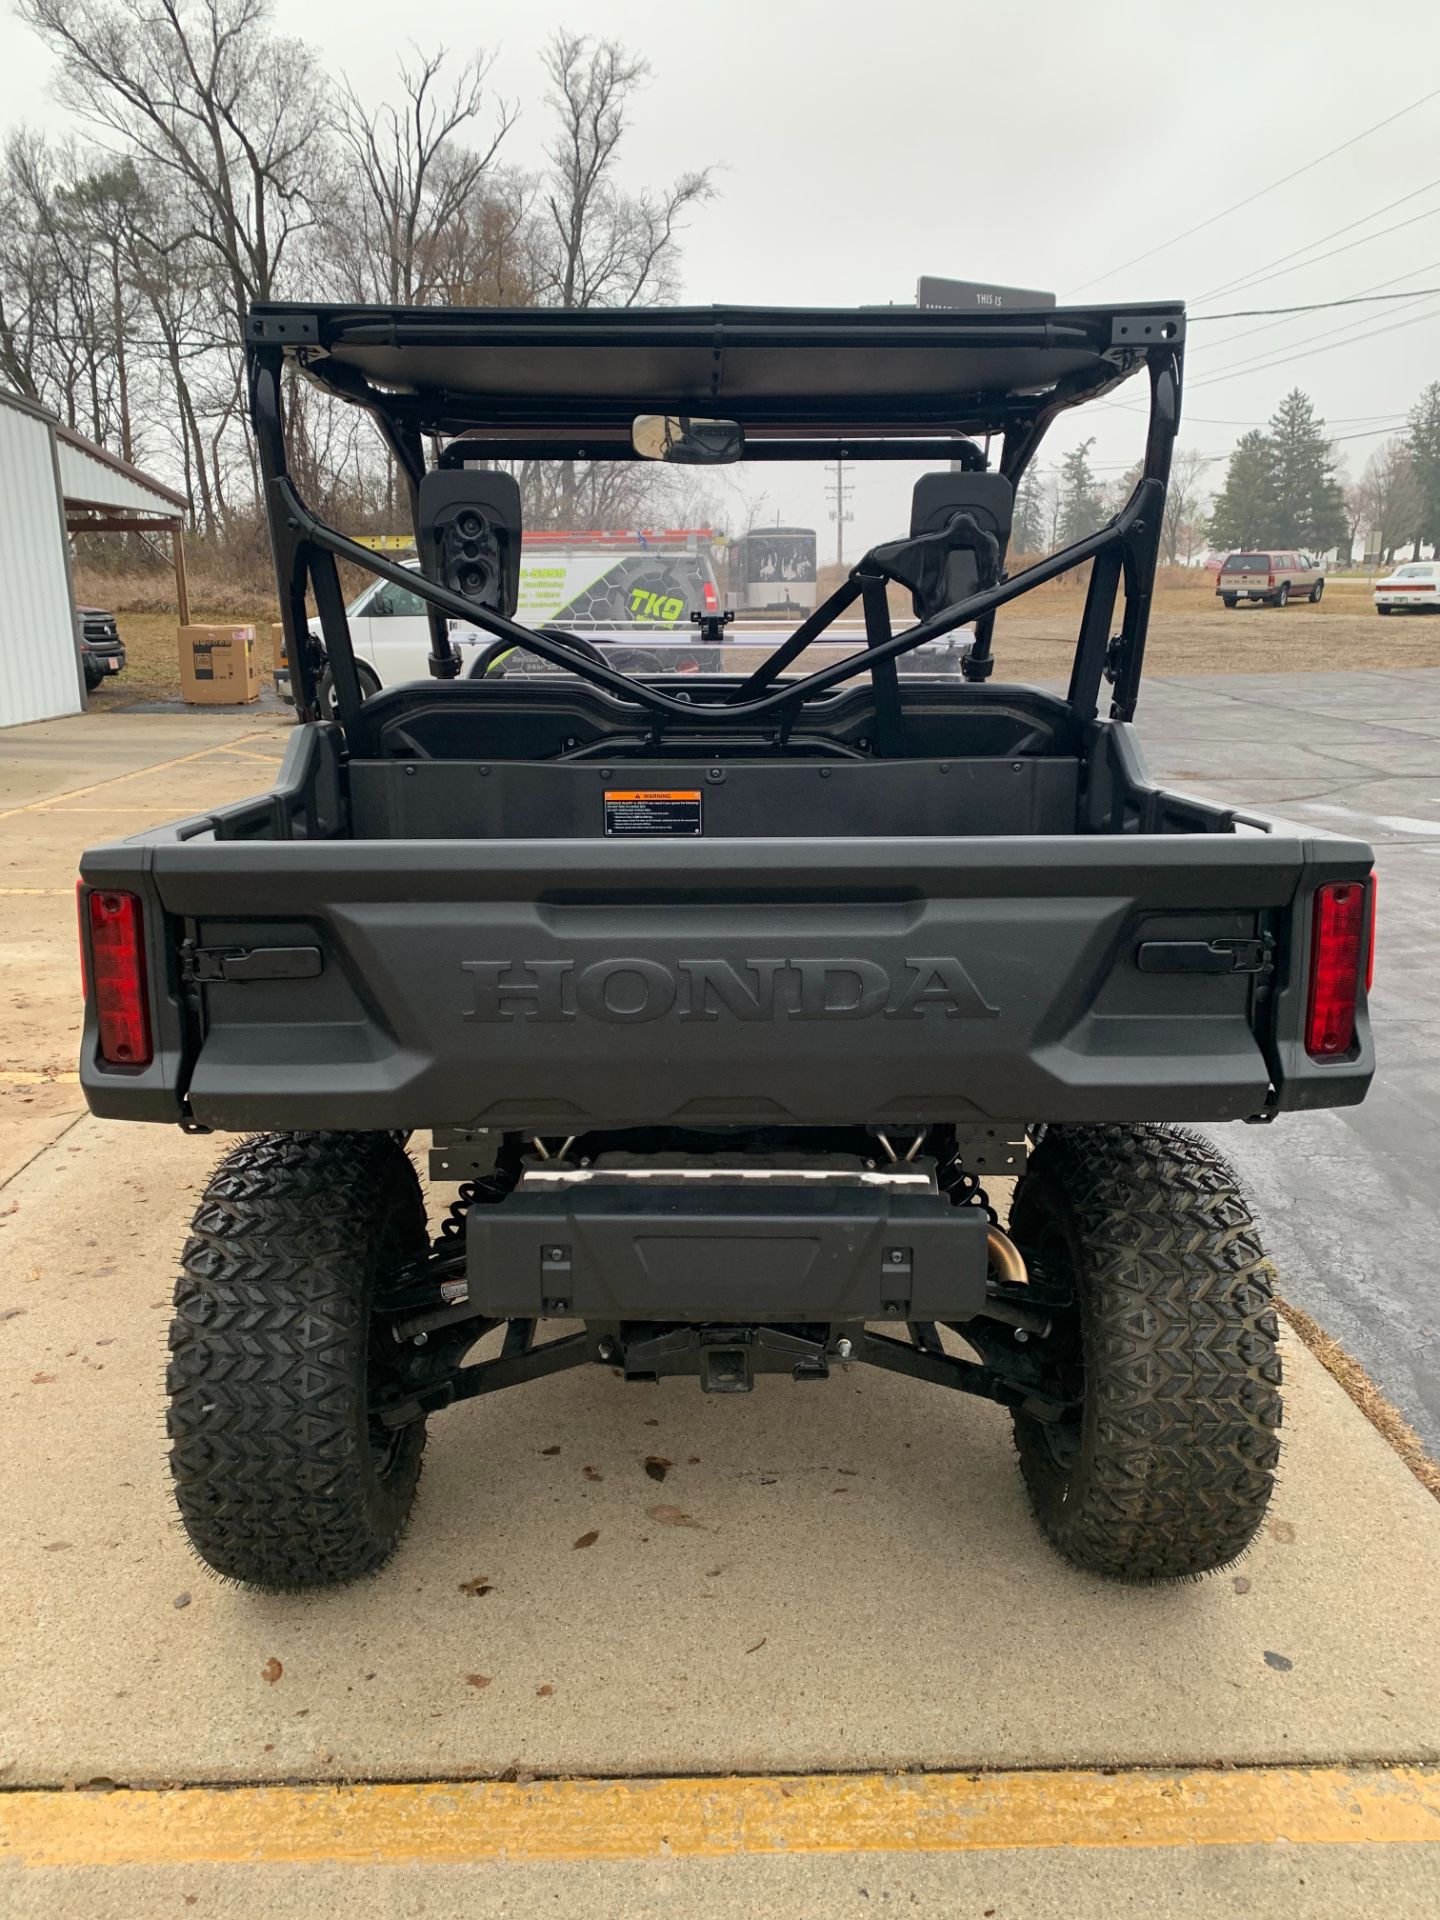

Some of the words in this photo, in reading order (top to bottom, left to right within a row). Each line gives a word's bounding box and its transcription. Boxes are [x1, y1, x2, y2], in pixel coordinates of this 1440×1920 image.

[976, 293, 993, 305] THIS
[994, 296, 1002, 306] IS
[630, 588, 684, 620] TKO
[461, 957, 1001, 1024] HONDA
